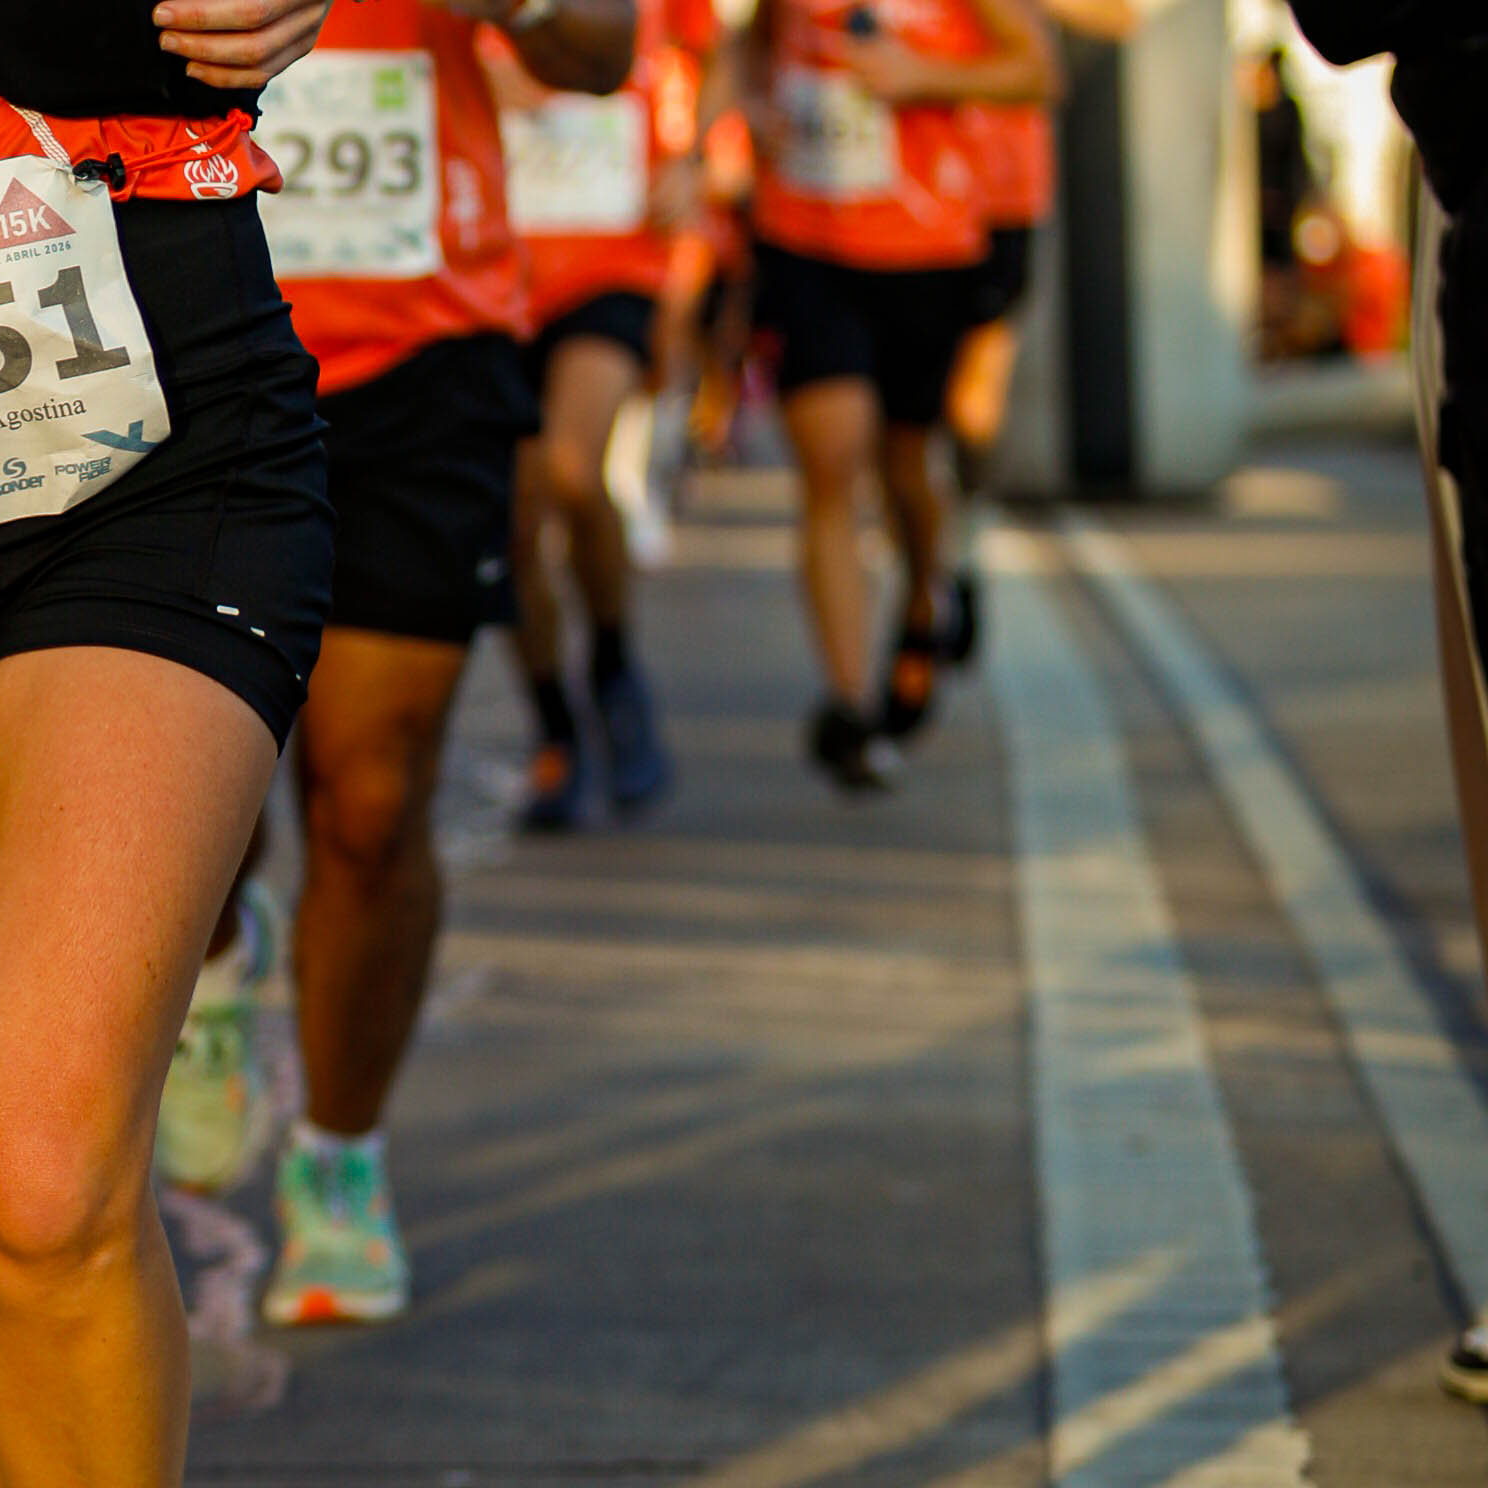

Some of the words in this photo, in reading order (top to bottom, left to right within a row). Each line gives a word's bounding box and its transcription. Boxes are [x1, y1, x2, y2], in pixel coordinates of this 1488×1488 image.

[274, 128, 421, 197] 293
[6, 247, 41, 263] ABRIL
[45, 240, 72, 255] 2026
[54, 456, 112, 476] POWER
